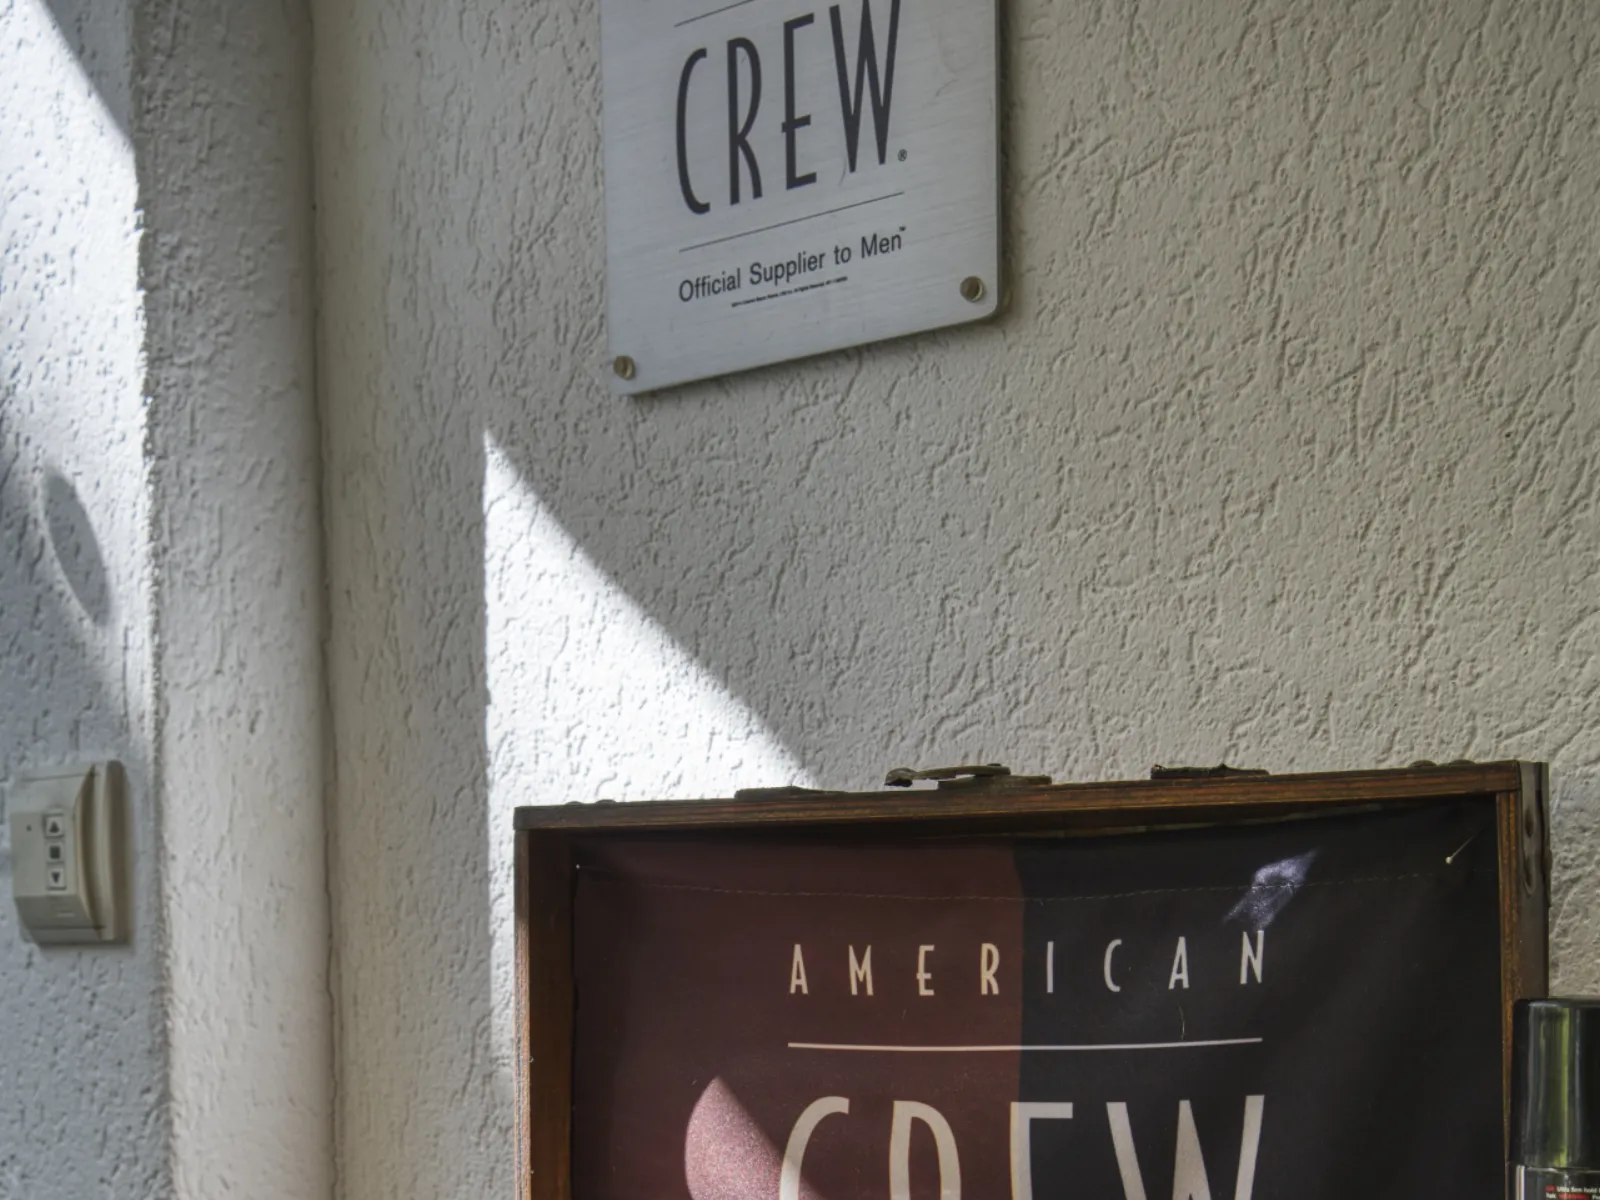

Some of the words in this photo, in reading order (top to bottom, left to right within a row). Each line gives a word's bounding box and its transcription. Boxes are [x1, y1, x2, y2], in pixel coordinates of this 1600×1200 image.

[676, 0, 901, 214] CREW
[678, 268, 742, 303] Official
[749, 252, 826, 287] Supplier
[833, 245, 852, 265] to
[788, 929, 1265, 997] AMERICAN
